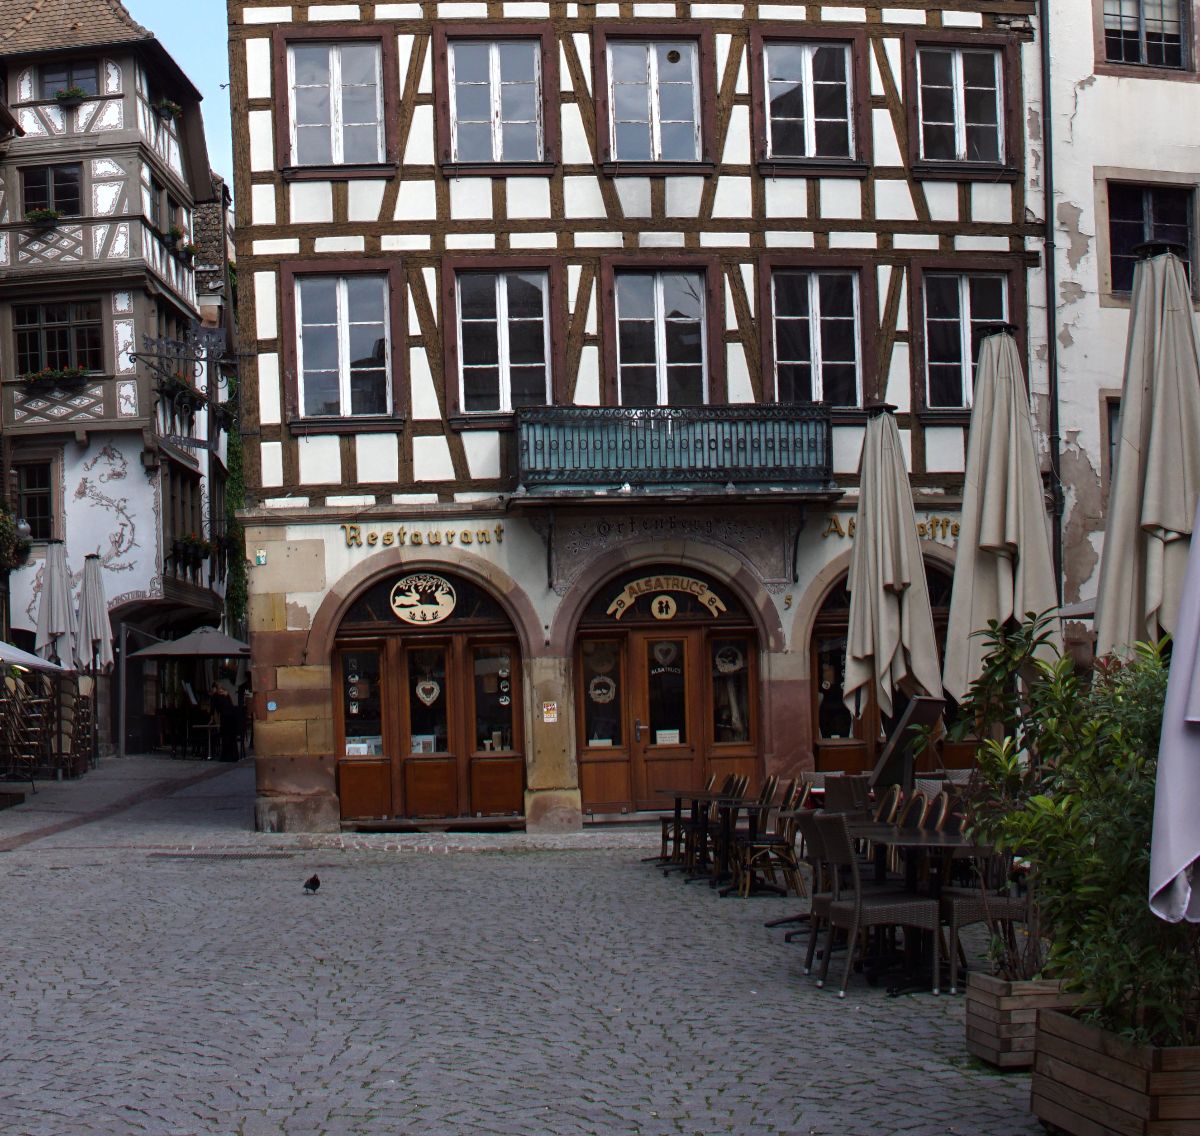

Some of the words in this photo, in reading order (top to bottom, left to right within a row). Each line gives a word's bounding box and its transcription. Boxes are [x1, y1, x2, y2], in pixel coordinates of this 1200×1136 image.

[341, 523, 504, 547] Restaurant
[627, 576, 708, 599] ALSATRUCS
[784, 594, 793, 611] 5
